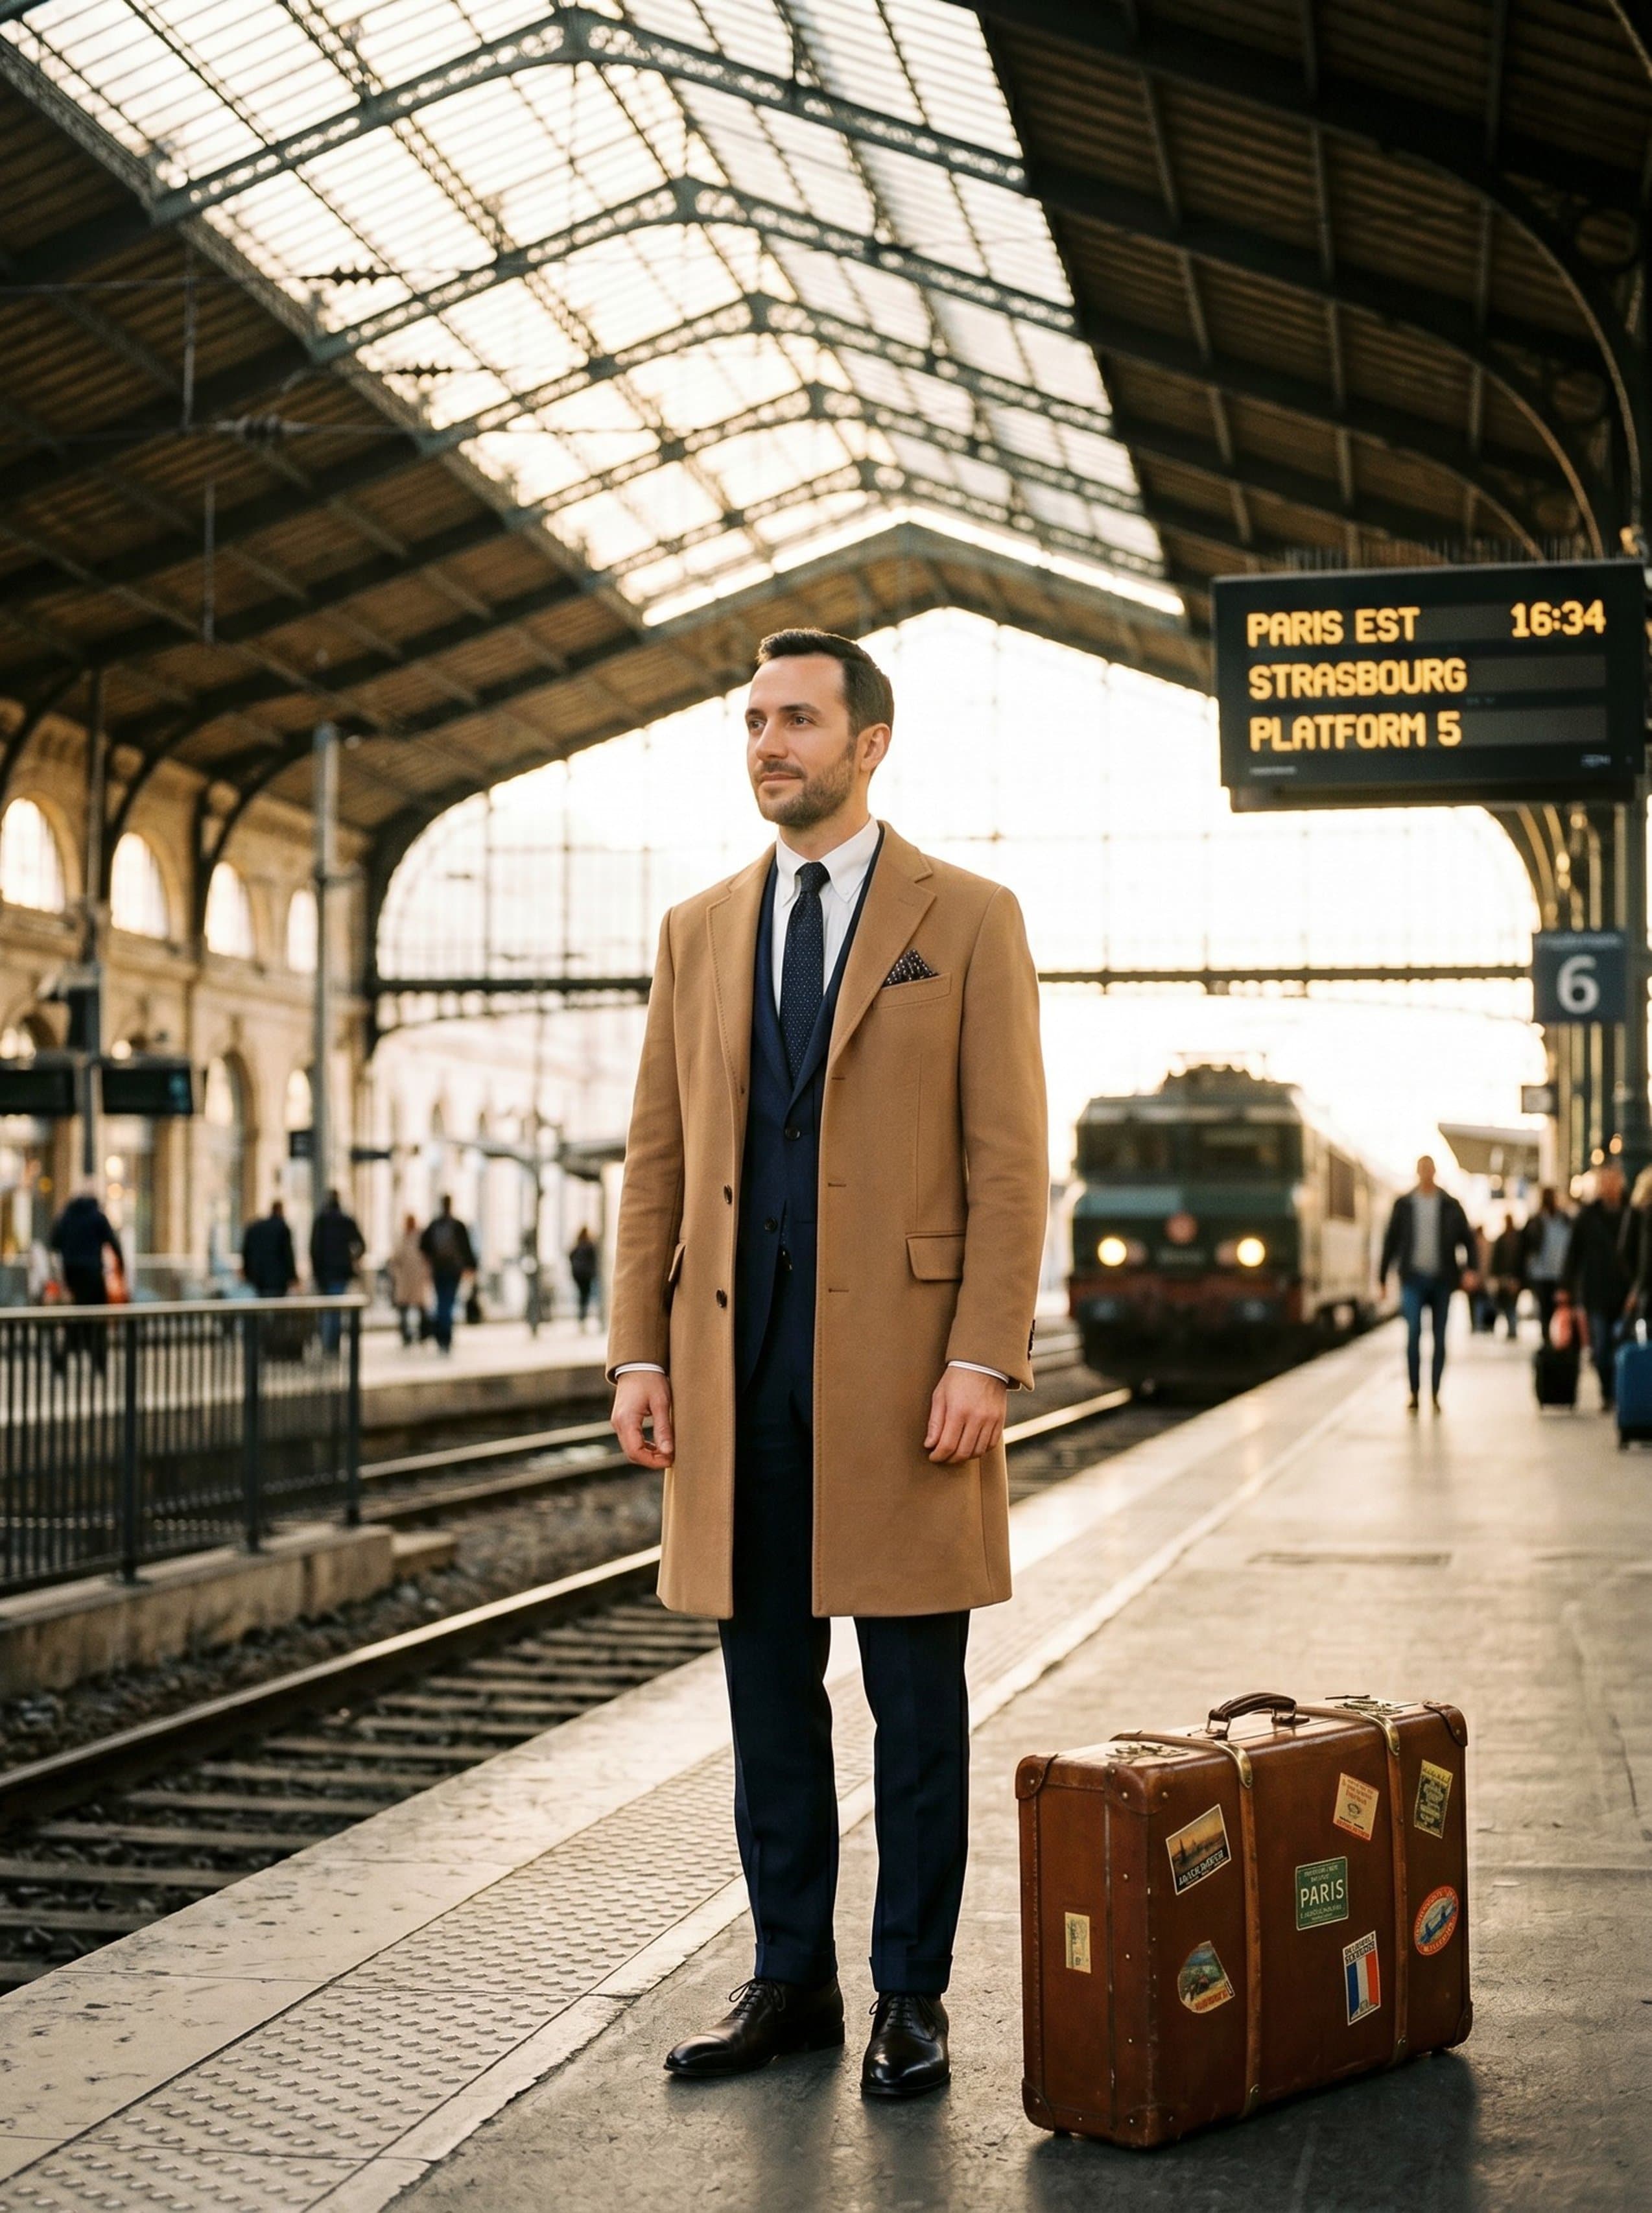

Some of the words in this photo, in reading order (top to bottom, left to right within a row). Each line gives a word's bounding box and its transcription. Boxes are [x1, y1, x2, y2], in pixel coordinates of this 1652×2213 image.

[1247, 609, 1344, 648] PARIS
[1355, 606, 1421, 644] EST
[1511, 599, 1607, 638] 16:34
[1248, 657, 1468, 700] STRASBOURG
[1249, 712, 1427, 752] PLATFORM
[1437, 710, 1462, 747] 5
[1557, 954, 1600, 1014] 6
[1300, 1878, 1344, 1908] PARIS
